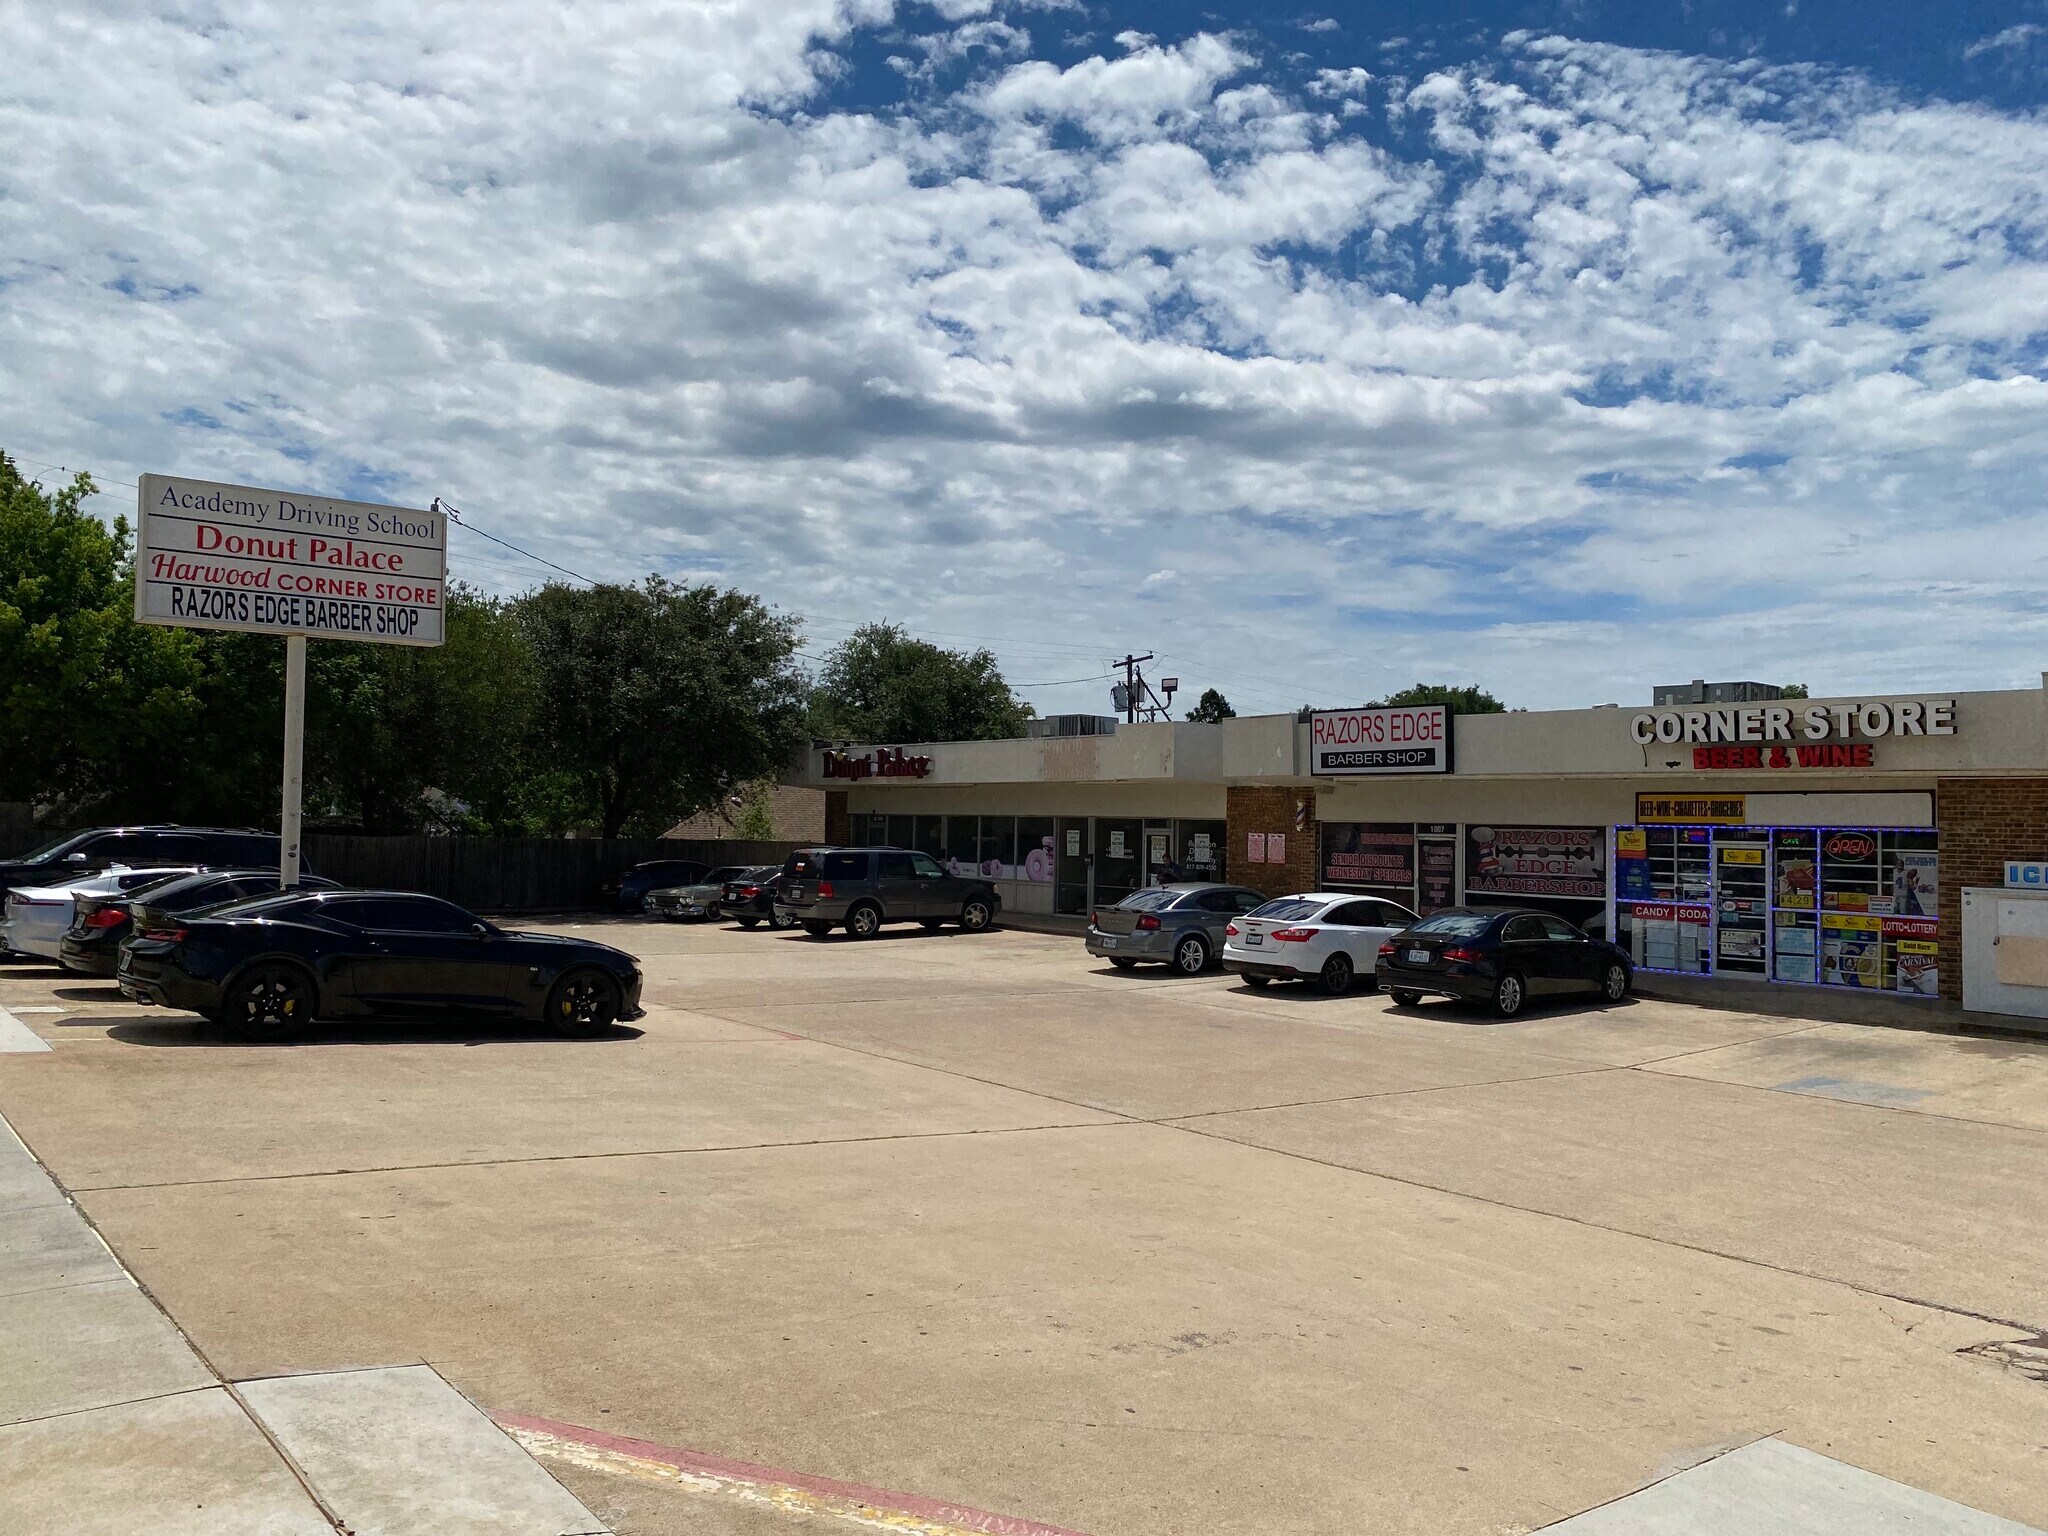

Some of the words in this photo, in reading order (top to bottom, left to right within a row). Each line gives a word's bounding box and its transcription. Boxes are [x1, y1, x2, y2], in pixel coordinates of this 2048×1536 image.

[160, 486, 269, 523] Academy
[278, 500, 360, 535] Driving
[367, 512, 435, 539] School
[196, 524, 298, 561] Donut
[309, 538, 404, 572] Palace
[151, 553, 272, 588] Harwood
[277, 573, 368, 598] CORNER
[375, 583, 437, 605] STORE
[172, 586, 249, 621] RAZORS
[254, 595, 300, 626] EDGE
[305, 600, 372, 633] BARBER
[377, 607, 419, 636] SHOP
[1314, 714, 1385, 744] RAZORS
[1390, 712, 1443, 741] EDGE
[1630, 707, 1796, 745] CORNER
[1803, 700, 1958, 741] STORE
[1328, 753, 1383, 766] BARBER
[1386, 751, 1427, 763] SHOP
[1693, 746, 1764, 770] BEER
[1769, 745, 1792, 769] &
[1795, 744, 1875, 768] WINE
[1500, 831, 1590, 846] RAZORS
[1828, 840, 1871, 855] OPEN
[1331, 853, 1359, 865] SENIOR
[1360, 854, 1405, 867] DISCOUNTS
[1515, 859, 1576, 875] EDGE
[1326, 866, 1373, 880] WEDNESDAY
[1373, 868, 1413, 882] SPECIALS
[2009, 865, 2048, 884] IC
[1469, 876, 1606, 895] BARBERSHOP
[1635, 907, 1670, 917] CANDY
[1679, 909, 1709, 919] SODA
[1898, 957, 1937, 967] CARNIVAL
